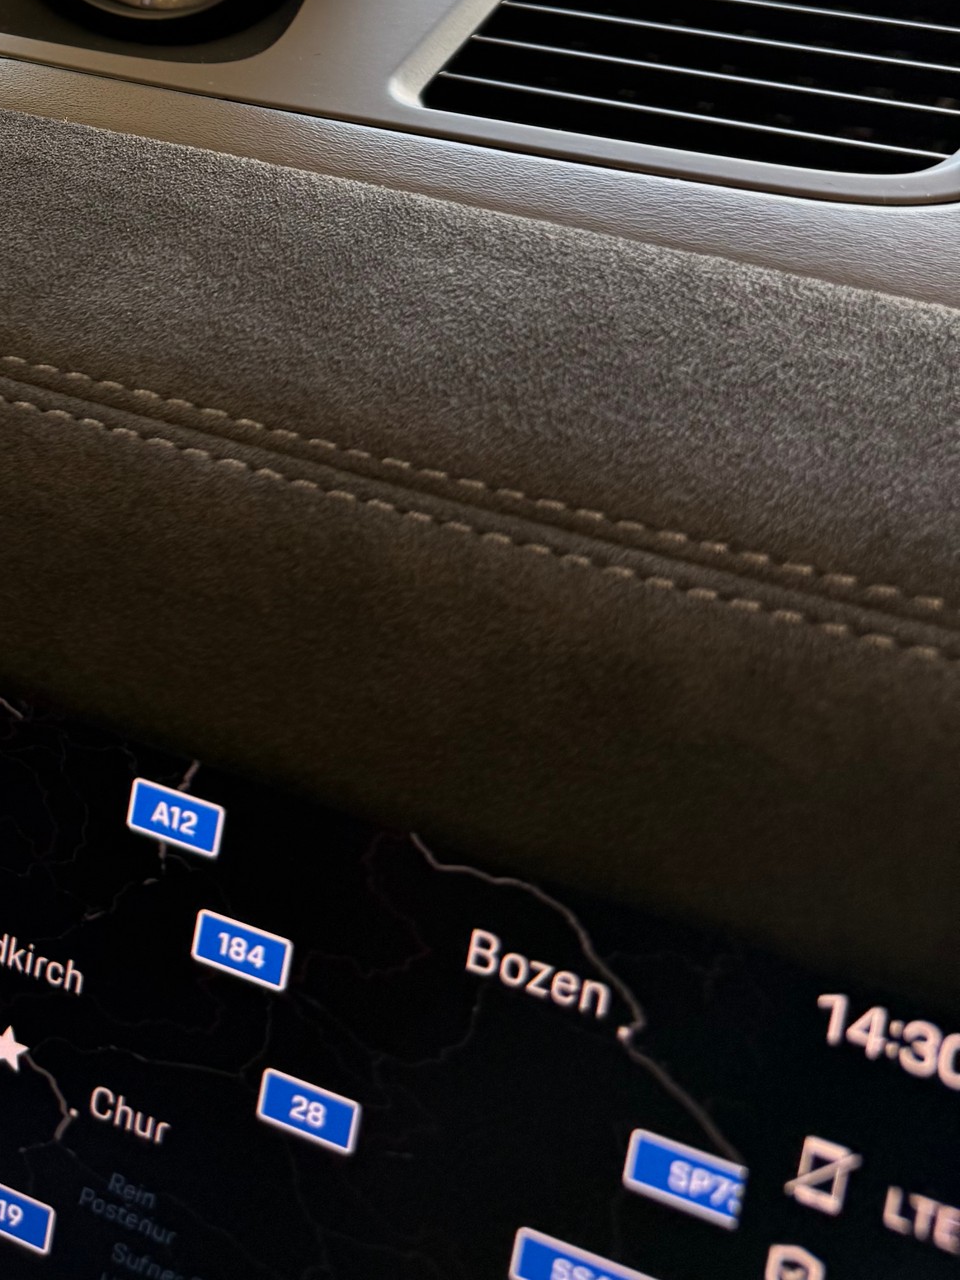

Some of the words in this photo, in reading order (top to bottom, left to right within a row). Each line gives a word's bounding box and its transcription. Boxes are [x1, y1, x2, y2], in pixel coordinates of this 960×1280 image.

[151, 801, 199, 837] A12
[218, 932, 266, 970] 184
[466, 929, 612, 1018] Bozen
[90, 1087, 170, 1145] Chur
[288, 1095, 327, 1129] 28
[108, 1172, 156, 1208] Rein
[883, 1186, 960, 1255] LTE
